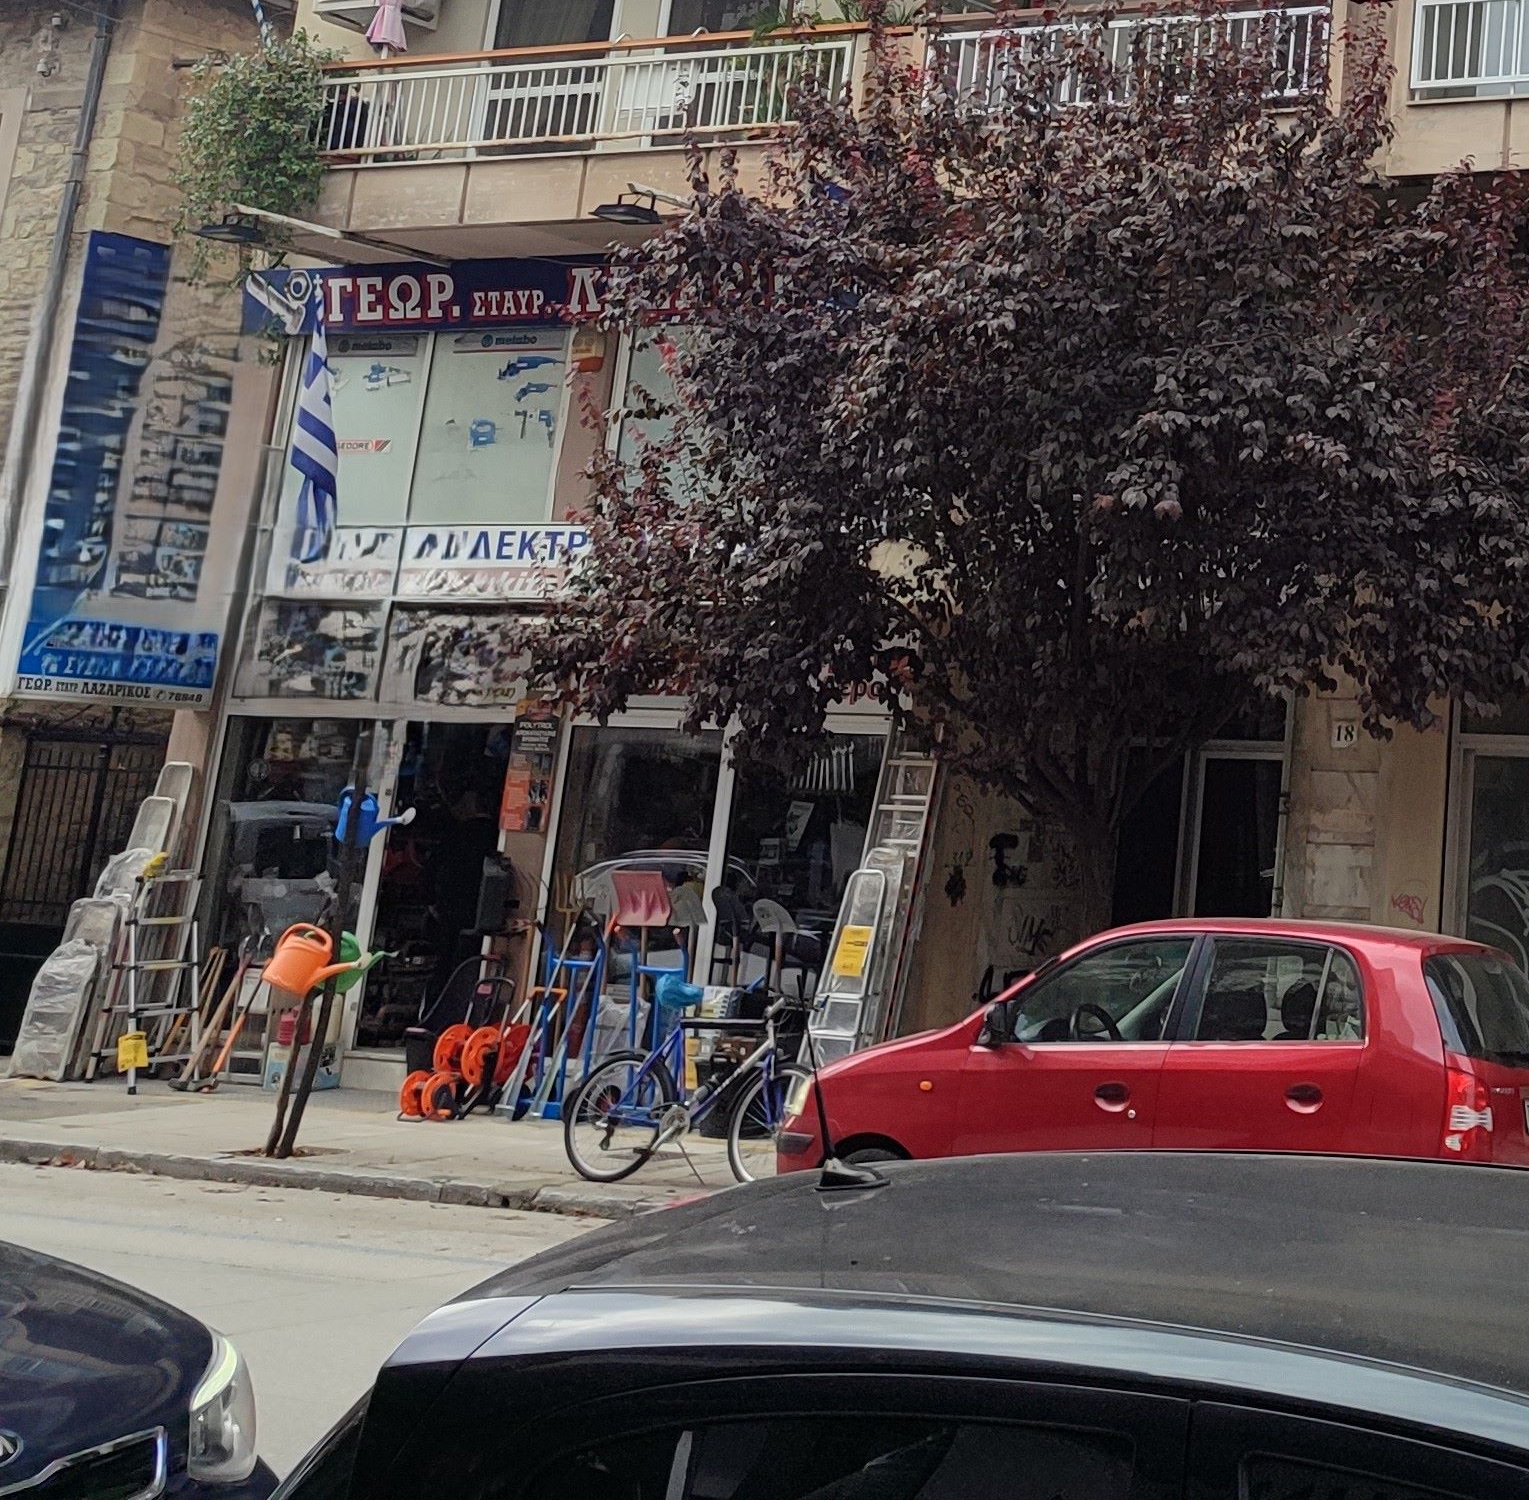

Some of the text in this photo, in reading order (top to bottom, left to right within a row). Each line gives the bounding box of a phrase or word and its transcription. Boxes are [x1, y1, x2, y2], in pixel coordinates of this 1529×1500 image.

[327, 274, 552, 323] ΓΕΩΡ. ΣΤΑΥΡ.
[81, 682, 151, 698] ΛΑΖΑΡΙΚΟΣ
[1335, 724, 1355, 743] 18
